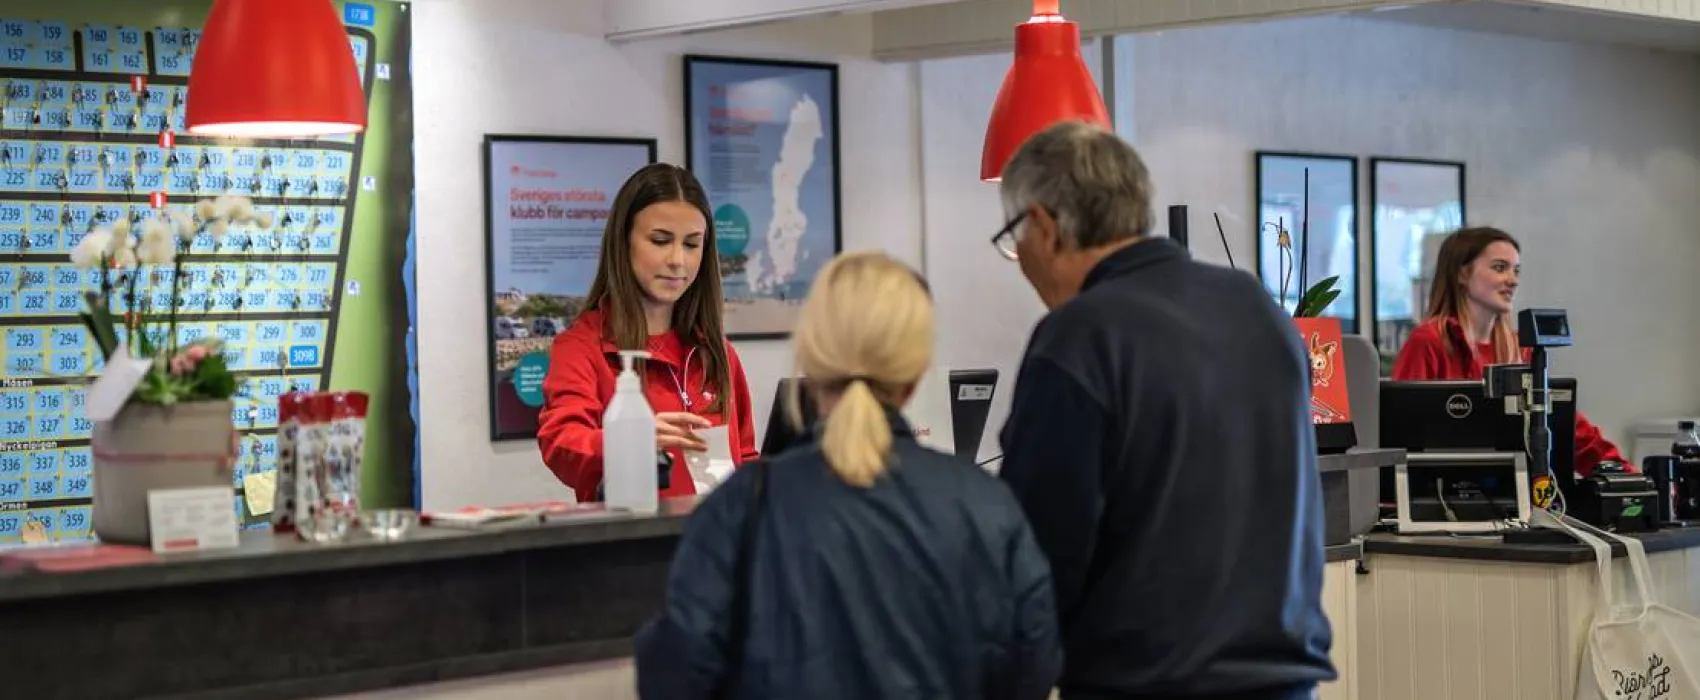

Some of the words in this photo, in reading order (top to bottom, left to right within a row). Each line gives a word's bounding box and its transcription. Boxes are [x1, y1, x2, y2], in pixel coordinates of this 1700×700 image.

[5, 23, 23, 37] 156
[43, 26, 62, 39] 159
[89, 29, 107, 42] 160
[119, 31, 138, 45] 163
[160, 31, 177, 45] 164
[8, 48, 26, 61] 157
[45, 50, 64, 63] 158
[92, 53, 109, 66] 161
[123, 54, 141, 68] 162
[161, 55, 179, 68] 165
[297, 155, 315, 168] 220
[327, 156, 343, 169] 221
[6, 172, 25, 185] 225
[74, 174, 94, 186] 227
[141, 174, 159, 188] 229
[1, 208, 20, 221] 239
[36, 209, 54, 222] 240
[510, 205, 545, 219] klubb
[547, 205, 564, 219] för
[1, 233, 20, 247] 253
[35, 233, 54, 247] 254
[315, 236, 331, 249] 263
[59, 271, 77, 284] 269
[280, 270, 297, 281] 276
[310, 269, 326, 282] 277
[25, 295, 44, 308] 282
[59, 295, 77, 308] 283
[246, 292, 265, 306] 289
[59, 332, 78, 346] 294
[263, 326, 280, 340] 299
[300, 325, 316, 339] 300
[16, 333, 35, 347] 293
[16, 357, 35, 372] 302
[60, 357, 78, 370] 303
[6, 396, 24, 409] 315
[41, 394, 60, 408] 316
[6, 420, 26, 434] 326
[41, 418, 59, 432] 327
[1, 458, 21, 472] 336
[36, 456, 54, 470] 337
[68, 454, 87, 468] 338
[0, 482, 19, 496] 347
[33, 481, 53, 494] 348
[67, 478, 87, 493] 349
[0, 518, 18, 532] 357
[66, 513, 84, 527] 359
